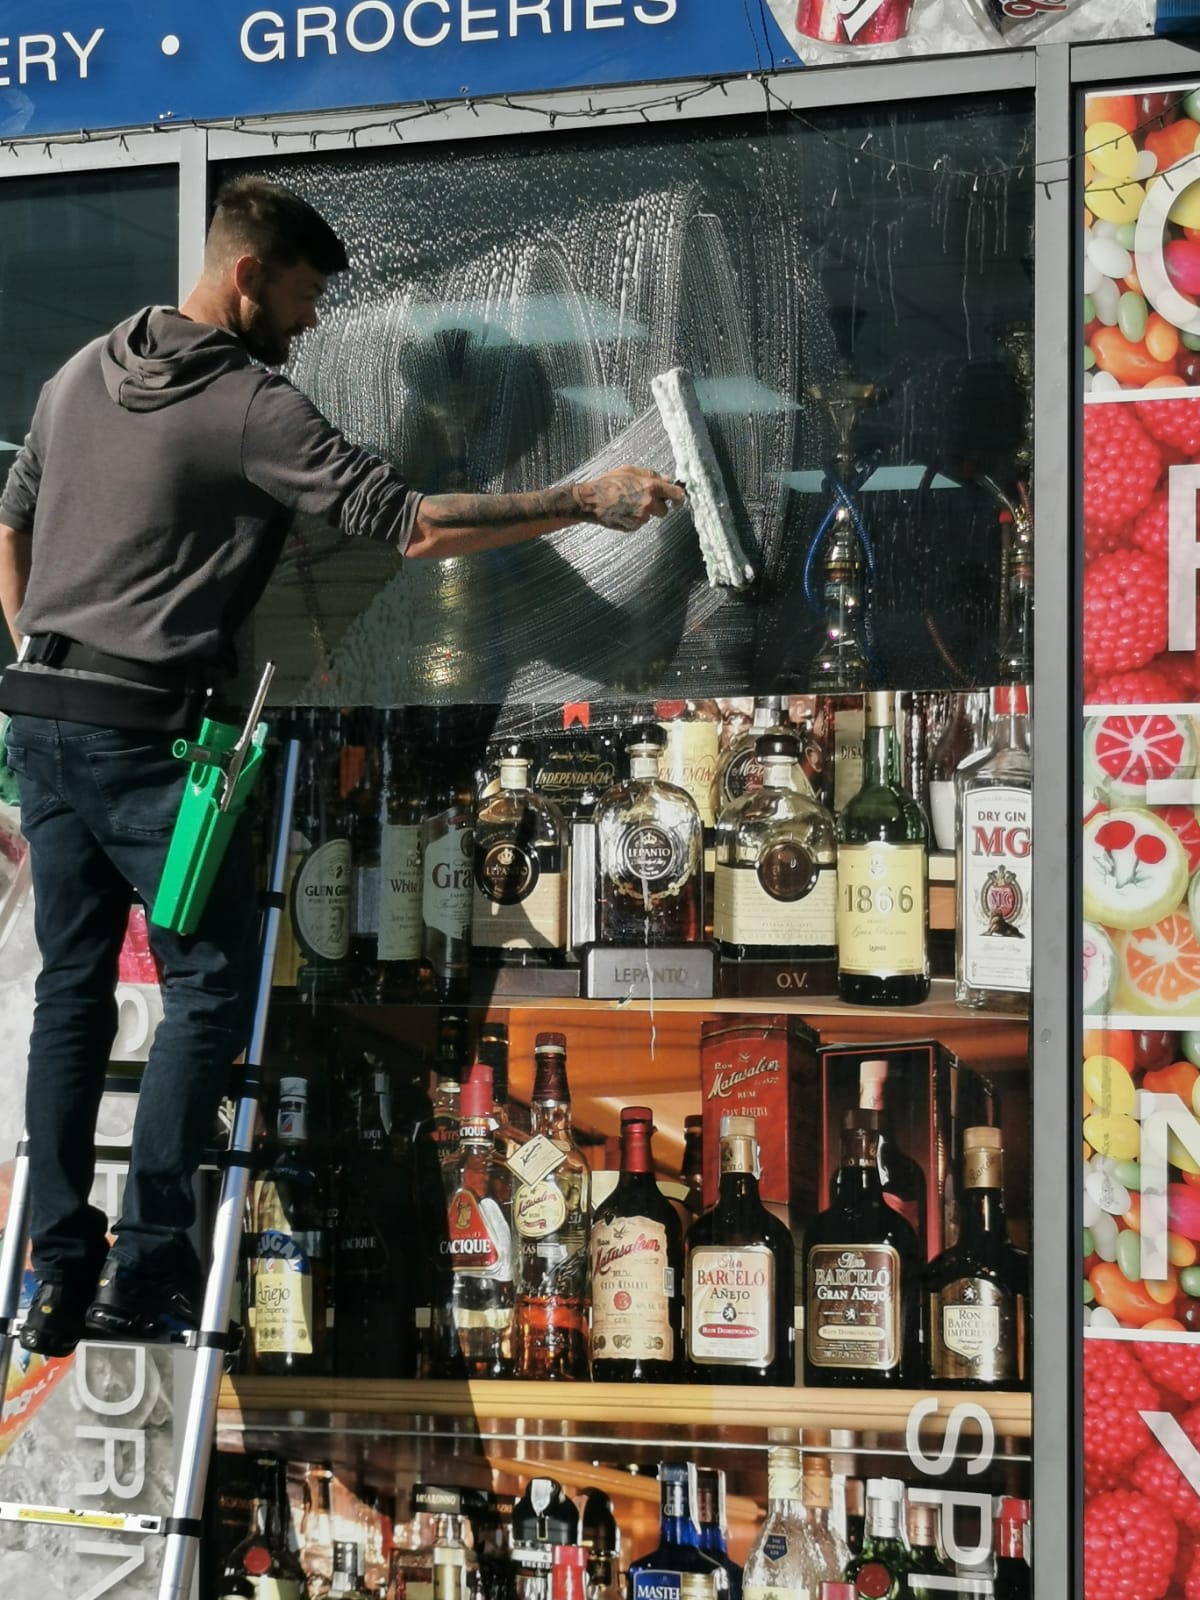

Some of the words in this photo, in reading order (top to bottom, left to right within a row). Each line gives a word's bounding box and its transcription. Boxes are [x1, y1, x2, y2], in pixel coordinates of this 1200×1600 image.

[240, 0, 678, 63] GROCERIES
[534, 765, 611, 786] INDEPENDENCIA
[977, 811, 1003, 822] DRY
[1006, 811, 1027, 822] GIN
[972, 826, 1032, 859] MG
[628, 847, 671, 858] LEPANTO
[844, 884, 914, 914] 1866
[614, 967, 689, 983] LEPANTO
[440, 1239, 491, 1254] CACIQUE
[814, 1266, 890, 1287] BARCELÓ
[709, 1287, 751, 1303] AÑEJO
[817, 1285, 849, 1300] GRAN
